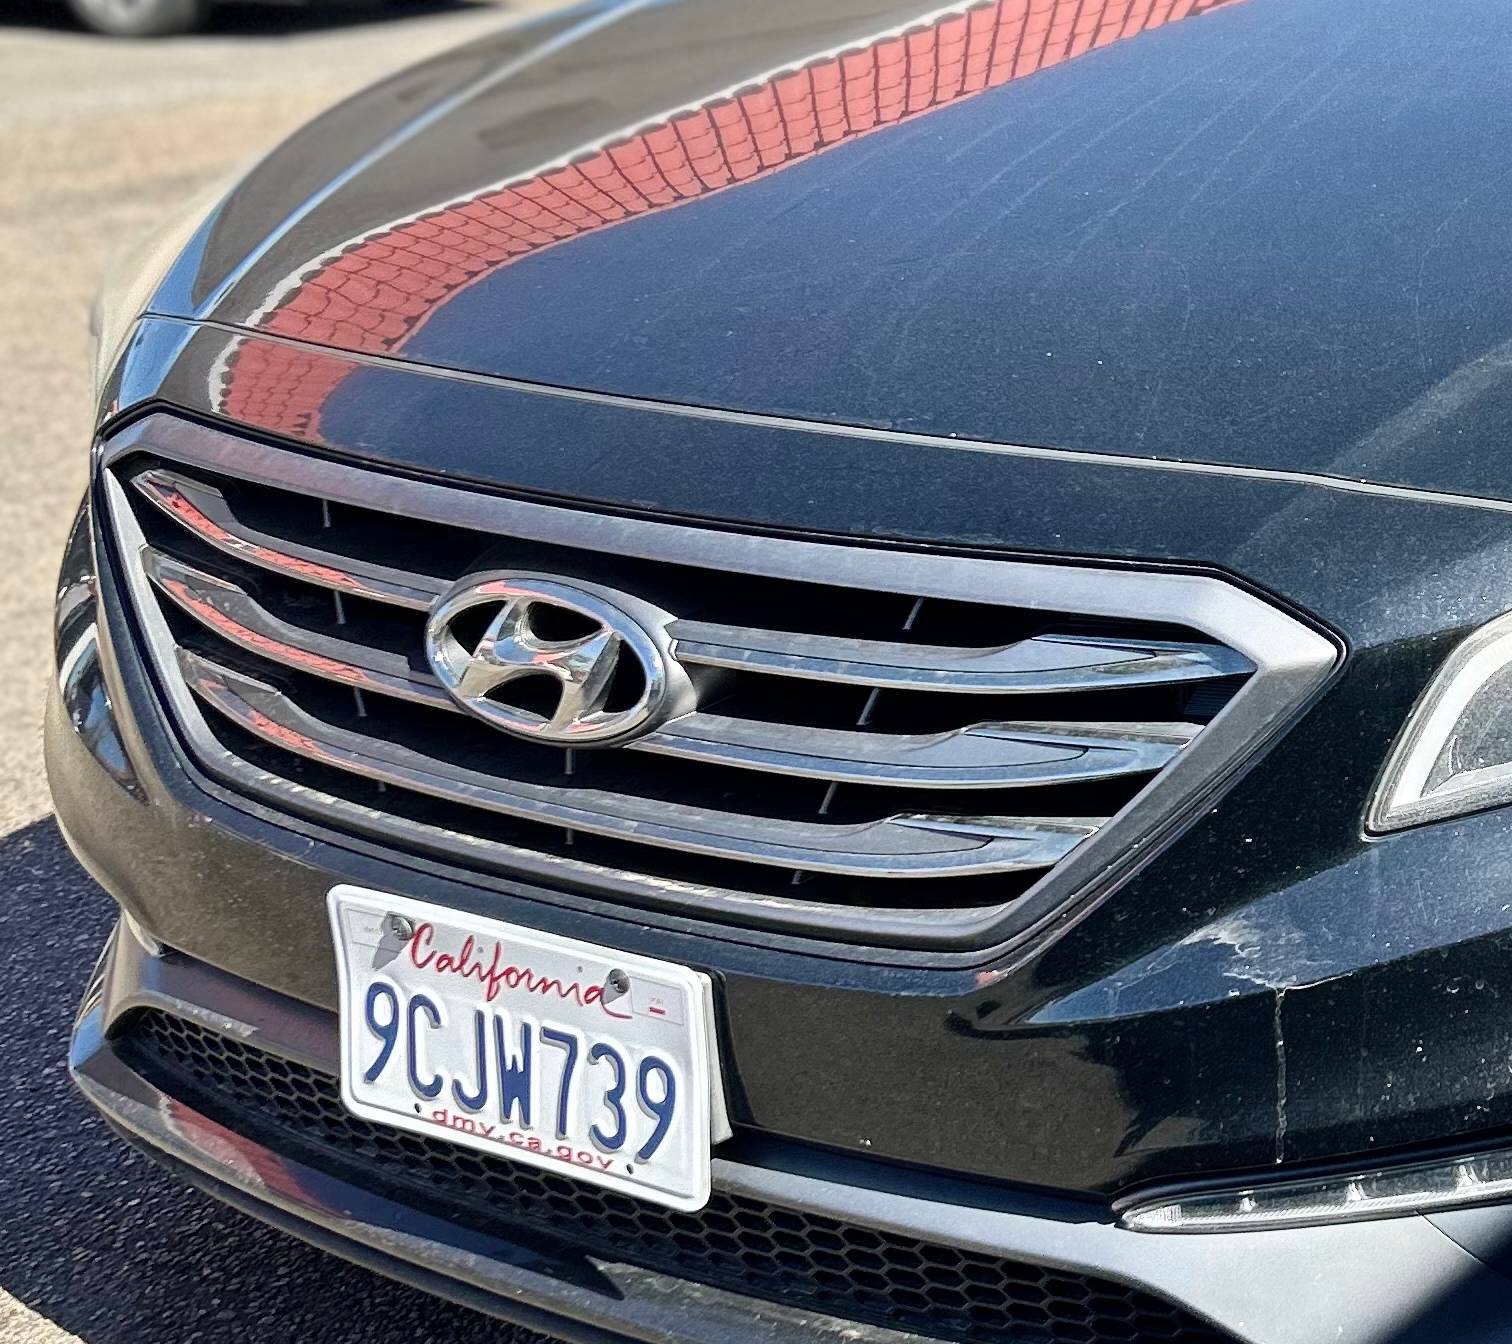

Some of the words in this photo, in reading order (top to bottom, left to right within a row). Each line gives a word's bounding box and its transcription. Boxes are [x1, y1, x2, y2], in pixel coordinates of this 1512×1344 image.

[411, 922, 632, 1019] California
[365, 981, 678, 1162] 9CJW739
[432, 1108, 614, 1169] dmv.ca.gov
